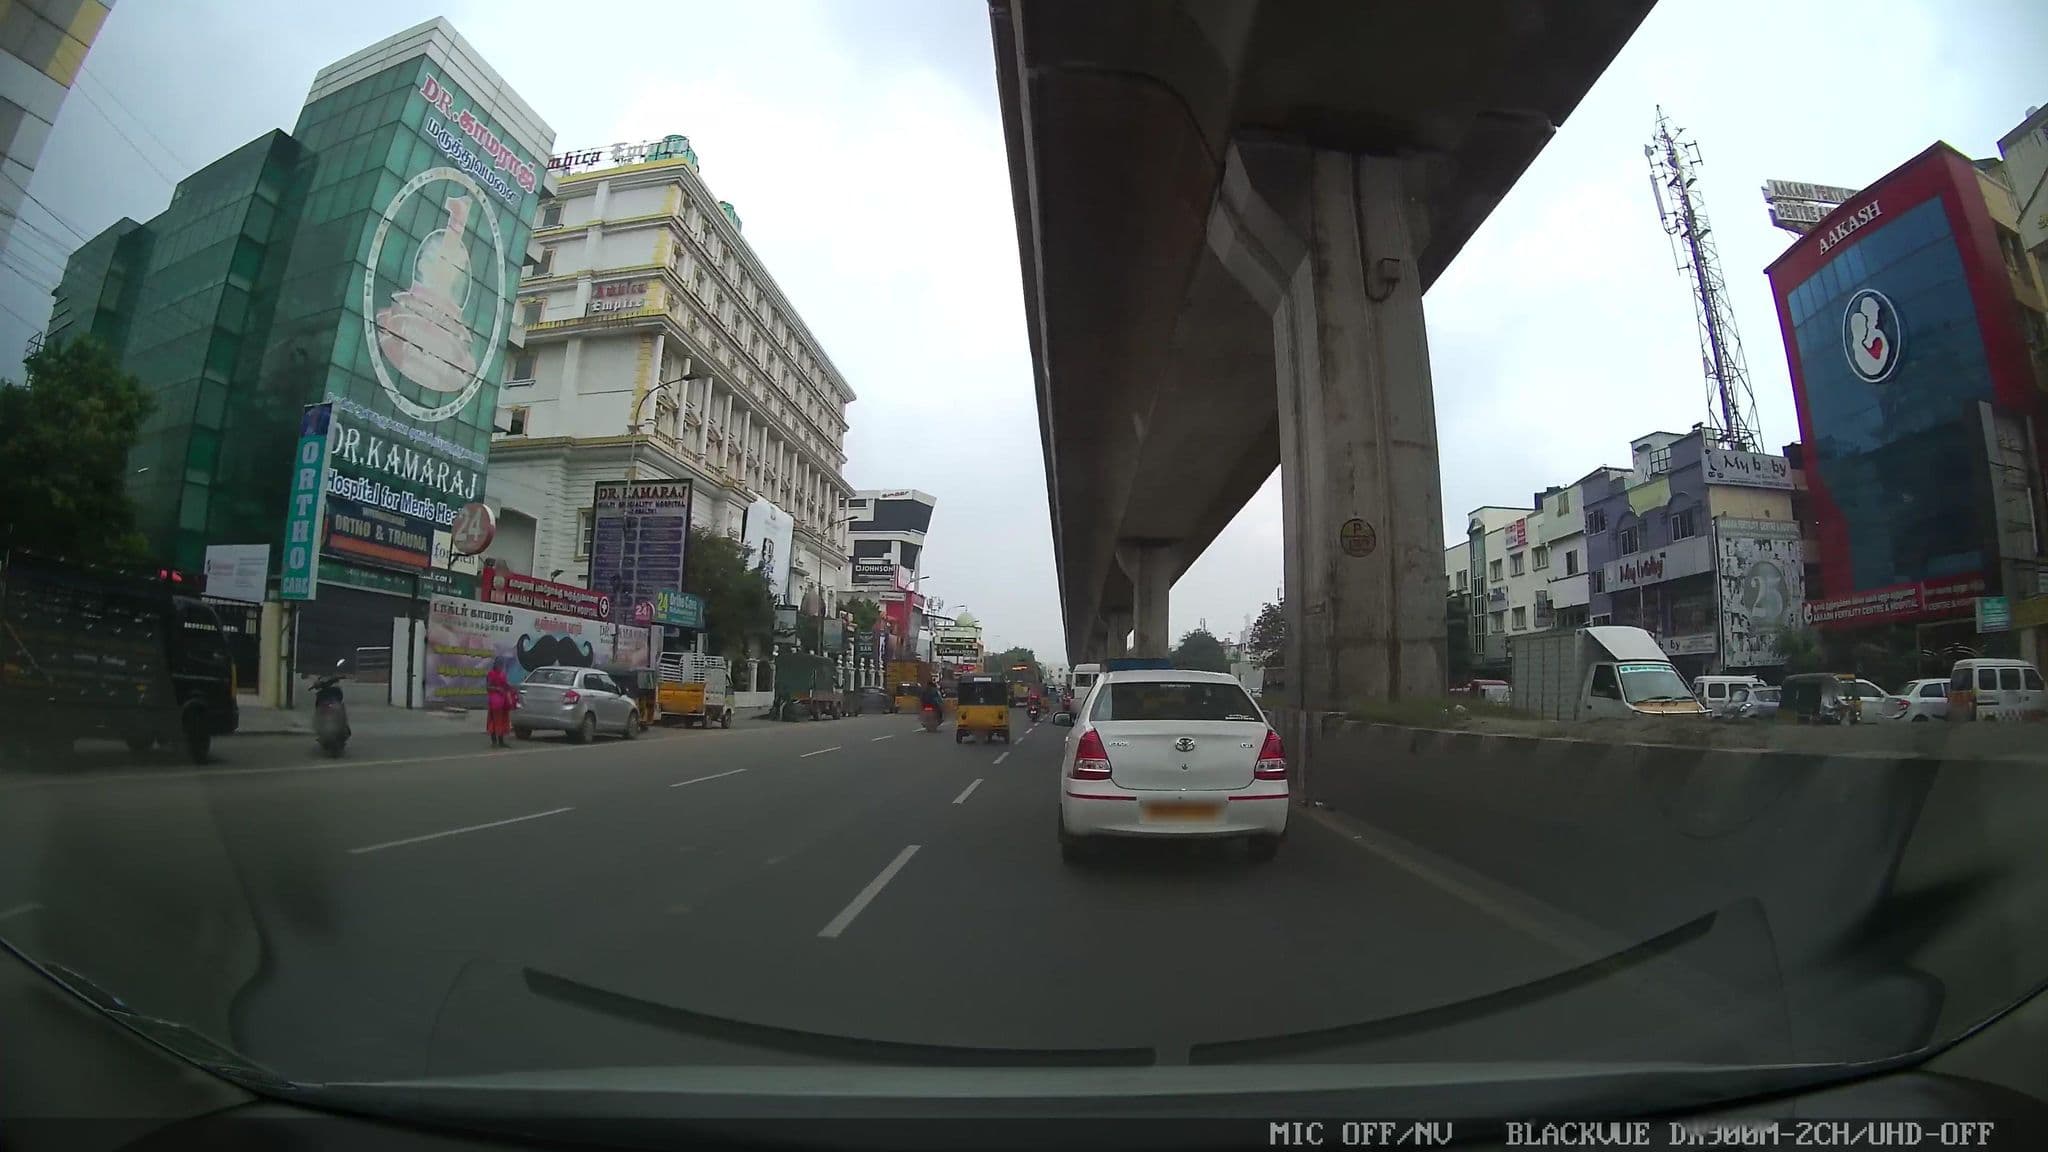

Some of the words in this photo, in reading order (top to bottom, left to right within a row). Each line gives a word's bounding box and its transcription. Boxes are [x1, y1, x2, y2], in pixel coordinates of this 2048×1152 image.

[547, 149, 602, 169] mbica
[1820, 200, 1883, 256] AAKASH
[1723, 455, 1749, 474] My
[1752, 456, 1787, 477] bby
[289, 441, 320, 571] ORTHO
[381, 486, 401, 513] for
[401, 491, 434, 520] Men's
[335, 514, 371, 537] ORTHO
[375, 524, 384, 541] &
[388, 527, 427, 551] TRAUMA
[456, 508, 483, 543] 24
[433, 542, 451, 558] for
[658, 592, 669, 612] 24
